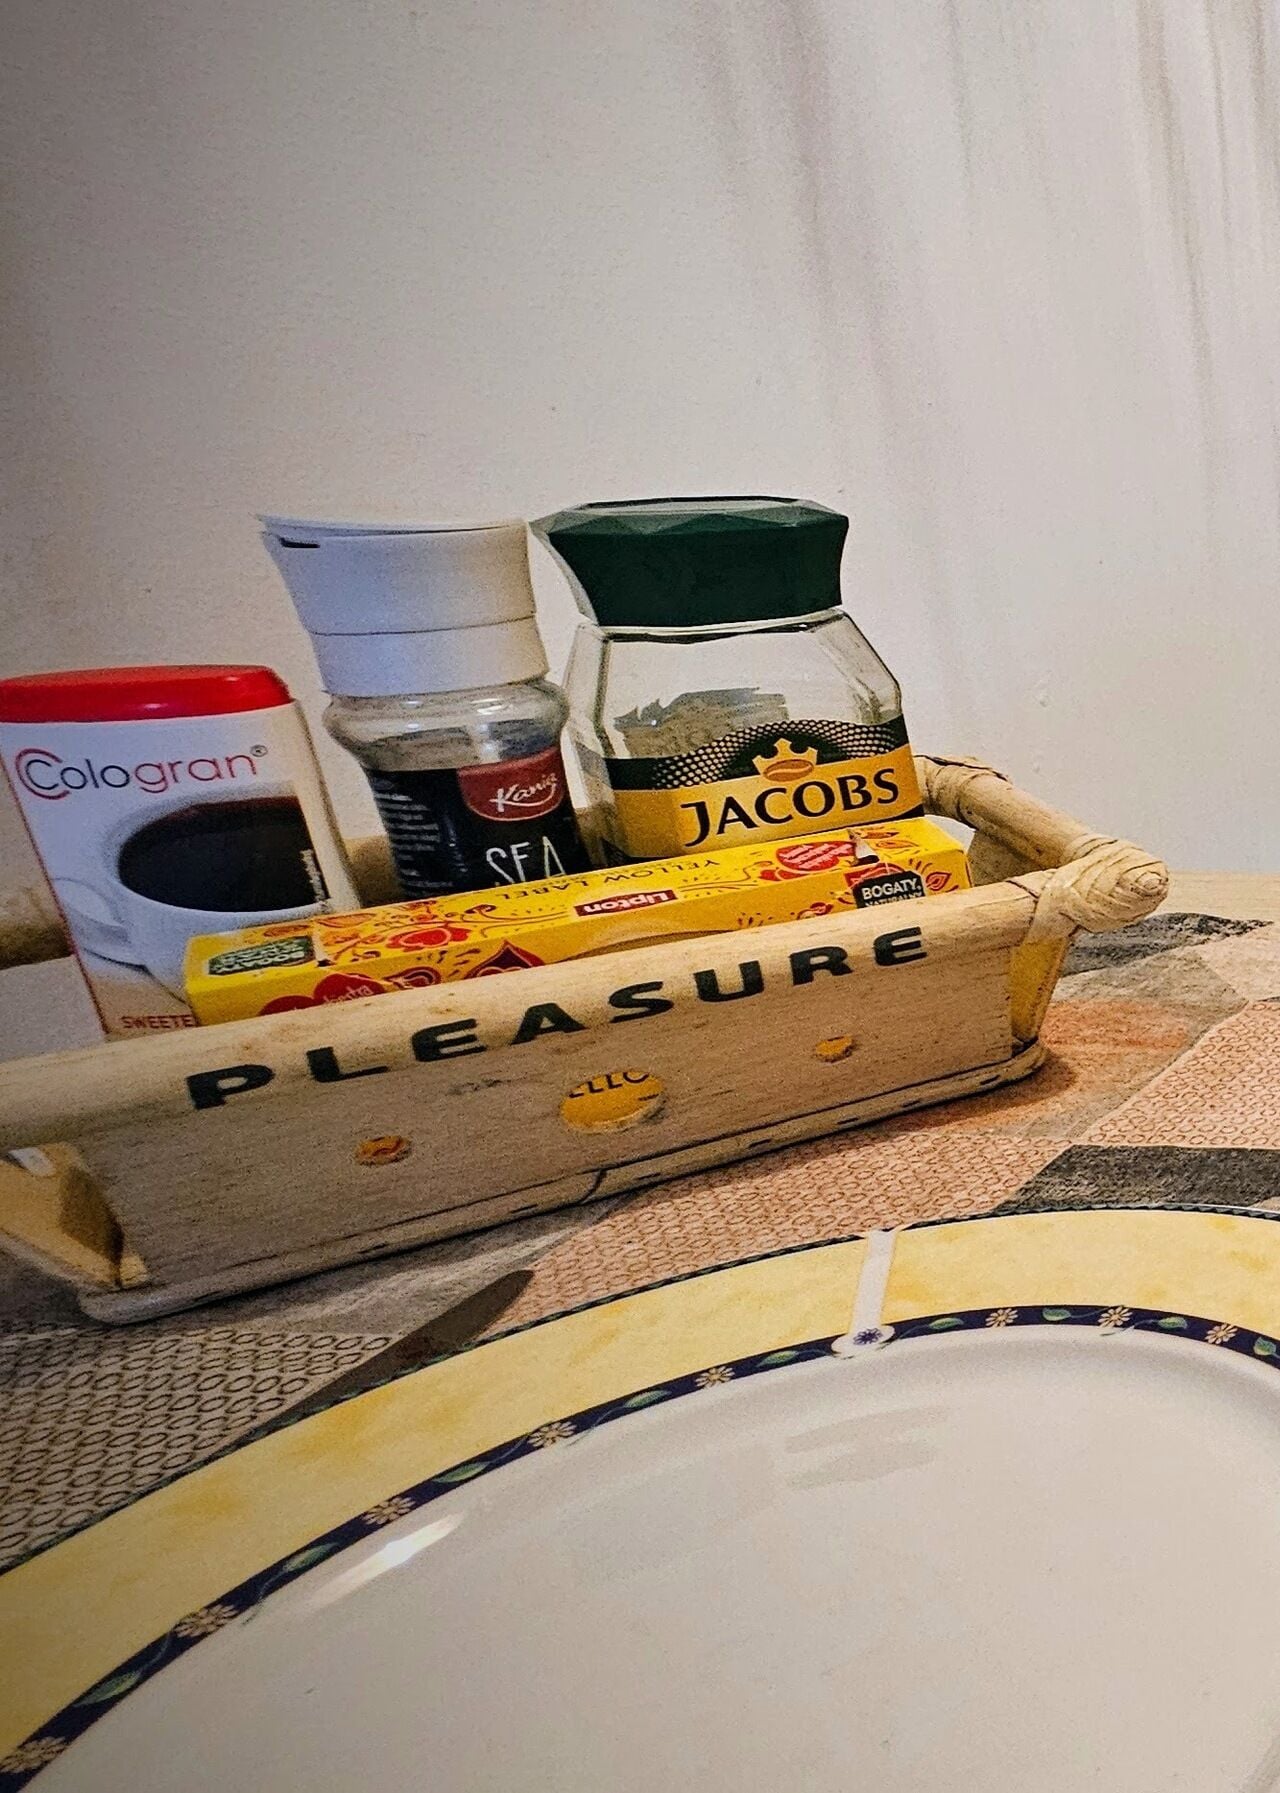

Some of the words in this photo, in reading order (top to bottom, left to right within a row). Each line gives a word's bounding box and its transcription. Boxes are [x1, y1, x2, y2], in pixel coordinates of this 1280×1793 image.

[489, 772, 559, 813] Kania
[680, 768, 899, 847] JACOBS
[486, 836, 566, 885] SEA
[604, 859, 719, 884] YELLOW
[502, 880, 588, 900] LABEL
[584, 892, 669, 914] Lipton
[185, 926, 928, 1110] PLEASURE
